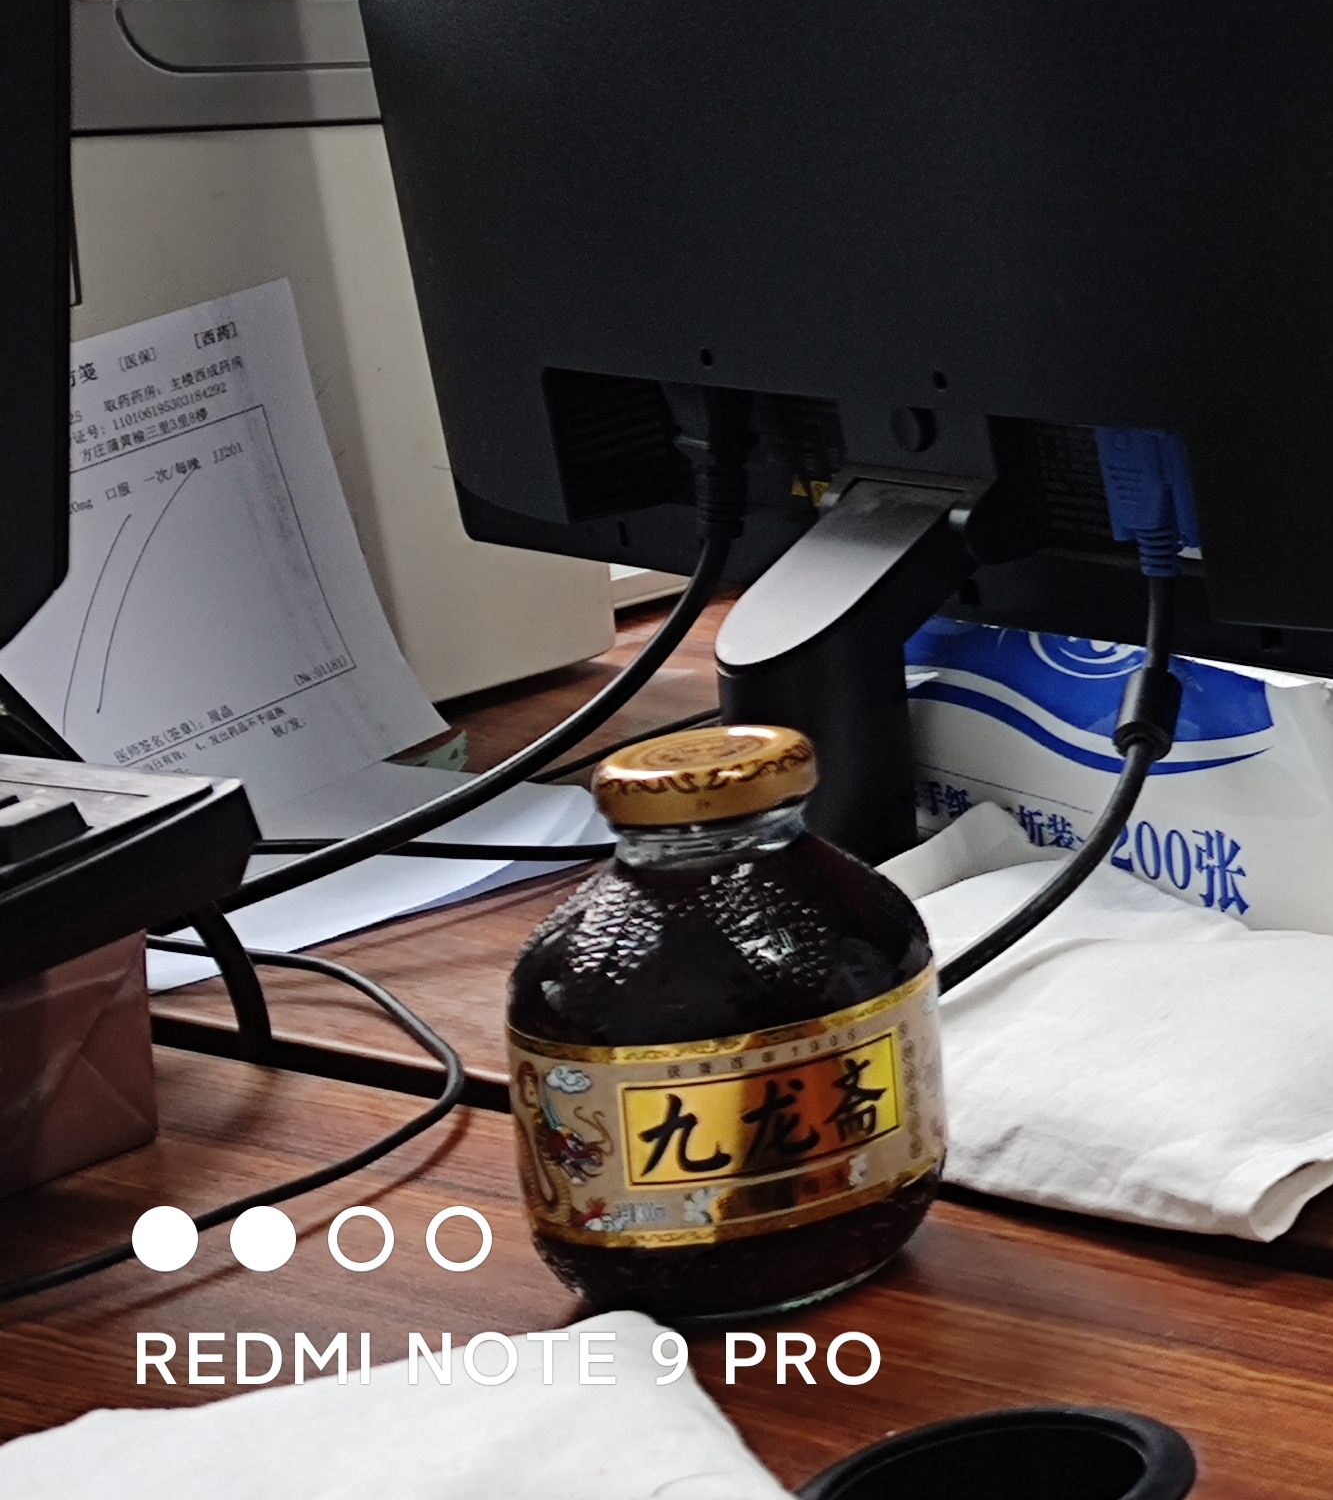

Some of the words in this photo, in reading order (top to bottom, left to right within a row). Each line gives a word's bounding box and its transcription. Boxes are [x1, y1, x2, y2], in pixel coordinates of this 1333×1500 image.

[1110, 819, 1250, 916] 200张
[639, 1058, 887, 1177] 九龙斋
